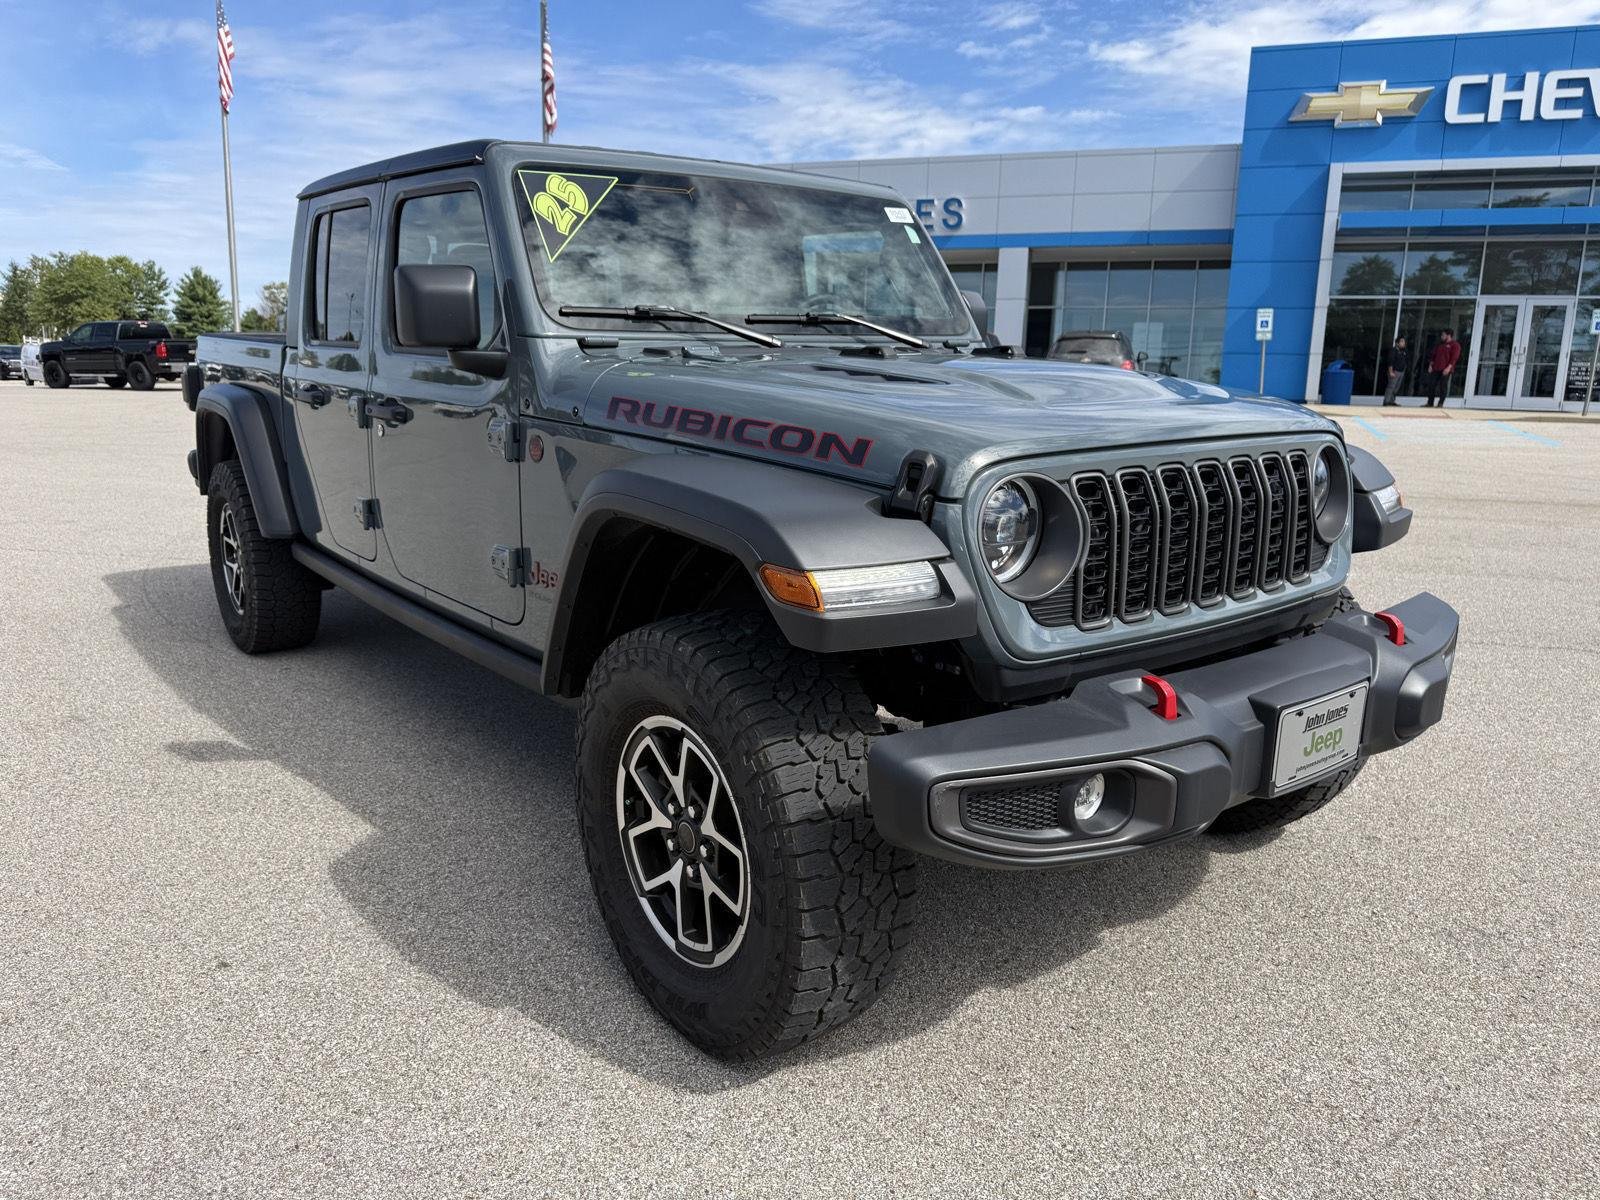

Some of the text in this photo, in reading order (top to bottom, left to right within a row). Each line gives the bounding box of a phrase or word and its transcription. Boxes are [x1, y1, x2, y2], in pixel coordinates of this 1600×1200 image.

[533, 174, 589, 236] 25
[606, 396, 874, 468] RUBICON
[1303, 703, 1350, 733] John Jones
[1303, 727, 1343, 757] Jeep
